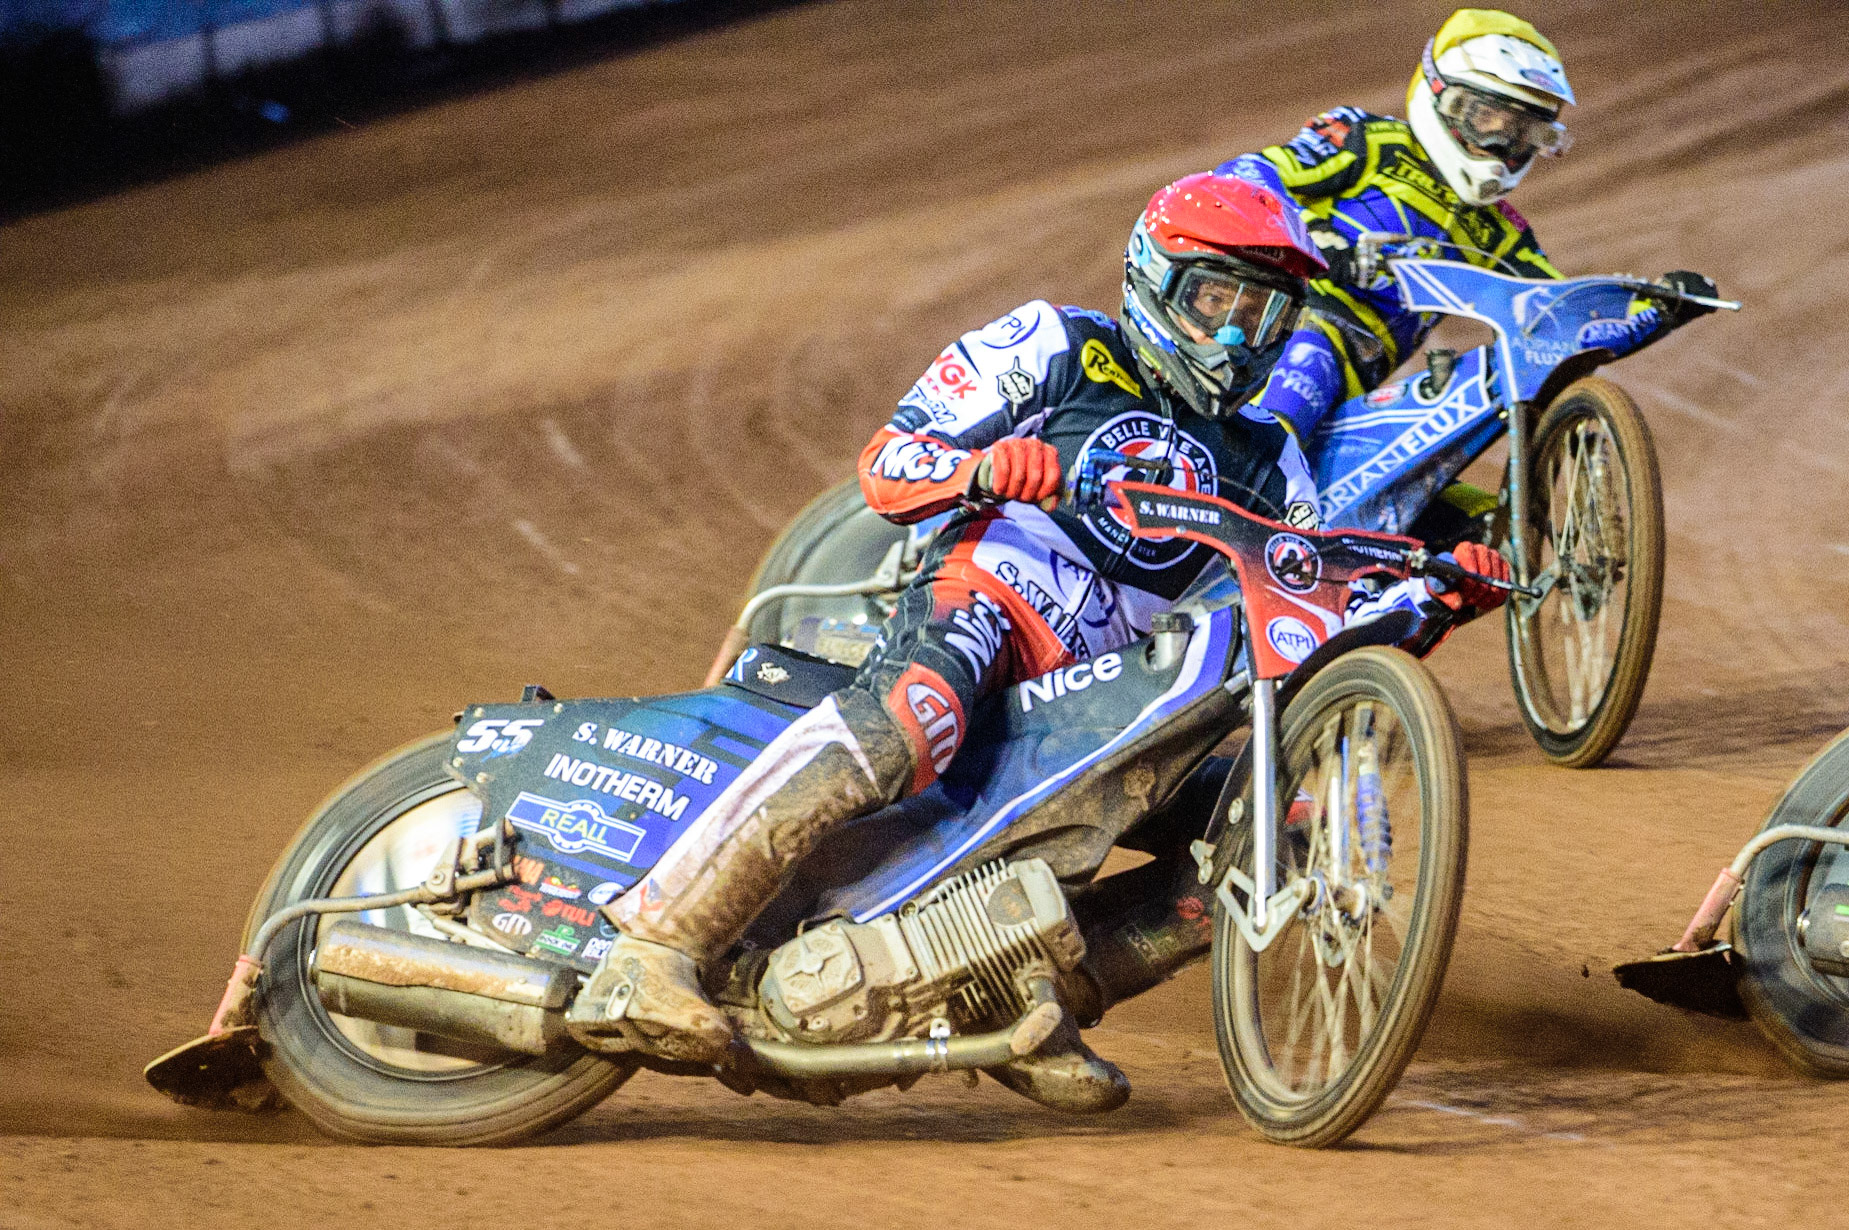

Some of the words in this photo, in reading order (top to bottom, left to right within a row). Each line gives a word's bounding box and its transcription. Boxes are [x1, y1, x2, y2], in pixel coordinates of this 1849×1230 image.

[1101, 421, 1151, 449] BELLE
[1159, 425, 1192, 454] VE
[1194, 457, 1211, 494] ACE
[1140, 501, 1155, 515] S.
[1156, 502, 1221, 524] WARNER
[1276, 631, 1310, 650] ATPI
[1019, 652, 1123, 713] Nice
[457, 719, 545, 753] 55
[572, 722, 598, 745] S.
[601, 727, 719, 786] WARNER
[544, 753, 692, 822] INOTHERM
[539, 811, 608, 845] REALL
